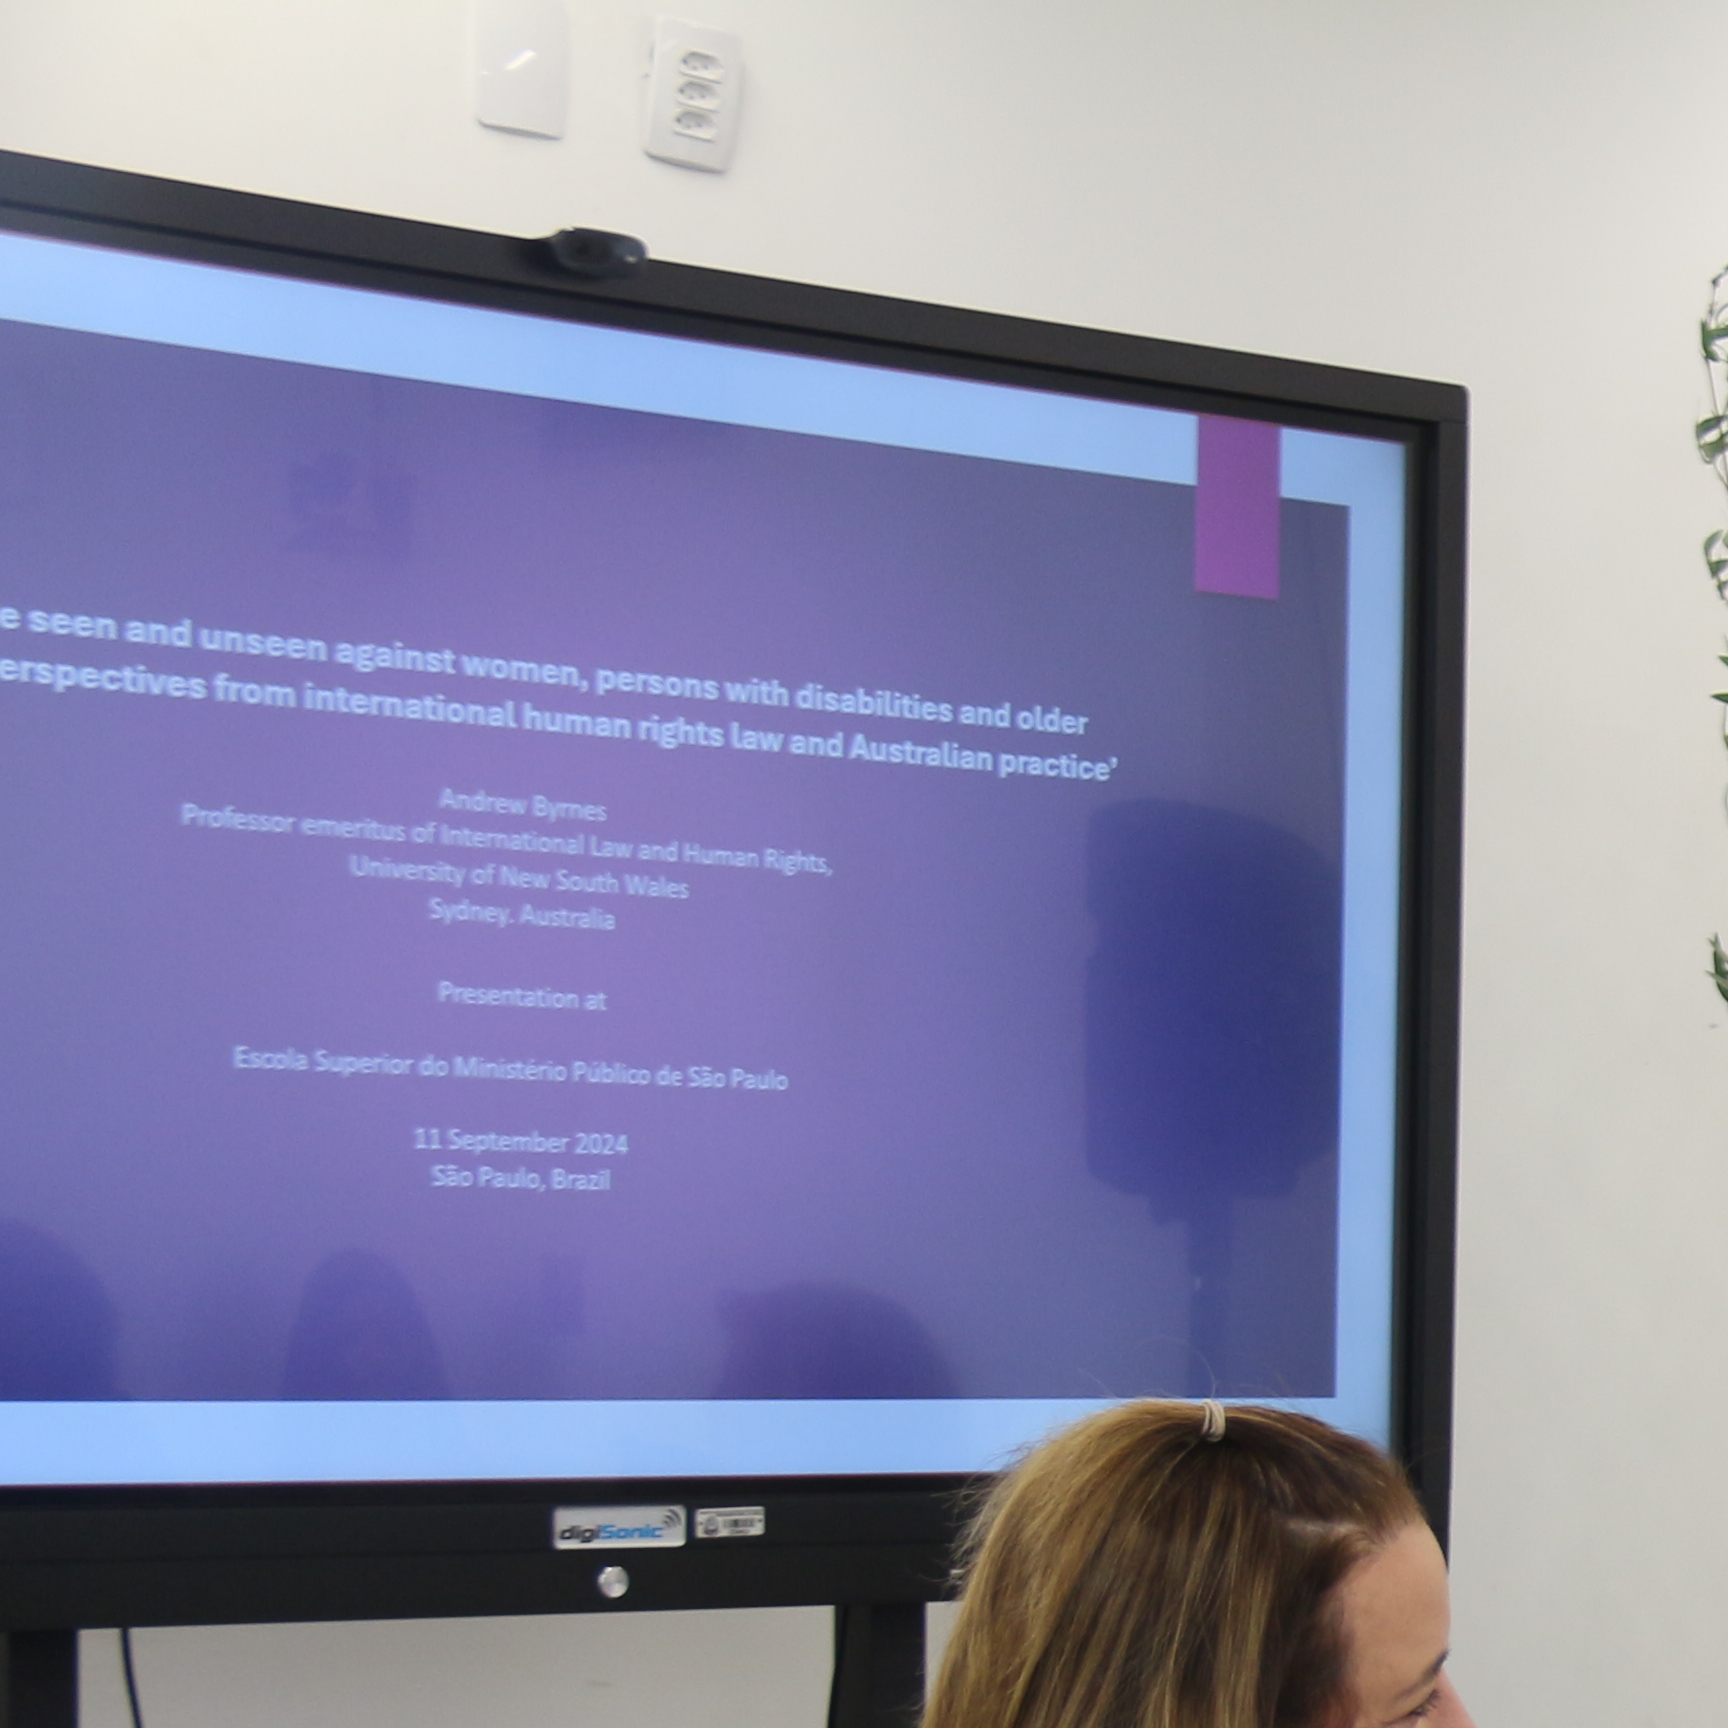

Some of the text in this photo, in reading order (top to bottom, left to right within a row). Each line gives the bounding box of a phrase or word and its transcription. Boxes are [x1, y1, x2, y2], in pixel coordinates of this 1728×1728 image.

[29, 612, 117, 640] seen
[126, 620, 192, 648] and
[201, 630, 327, 661] unseen
[336, 641, 456, 674] against
[463, 657, 589, 692] women,
[598, 671, 719, 700] persons
[726, 680, 789, 707] with
[797, 684, 953, 723] disabilities
[960, 704, 1011, 728] and
[1018, 707, 1089, 735] older
[0, 660, 207, 699] erspectives
[215, 672, 296, 708] from
[306, 684, 517, 728] international
[525, 704, 631, 739] human
[640, 717, 724, 749] rights
[733, 724, 784, 752] law
[791, 733, 844, 758] and
[850, 735, 993, 771] Australian
[440, 789, 608, 823] Andrew Byrnes
[182, 804, 834, 877] Professor emeritus of International Law and Human Rights,
[350, 856, 690, 900] University of New South Wales
[520, 905, 616, 931] Australia
[438, 981, 608, 1012] Presentation at
[234, 1046, 790, 1091] Escola Superior do Ministério Público de São Paulo
[415, 1128, 630, 1156] 11 September 2024
[432, 1165, 611, 1193] São Paulo, Brazil
[559, 1524, 665, 1543] digiSonic
